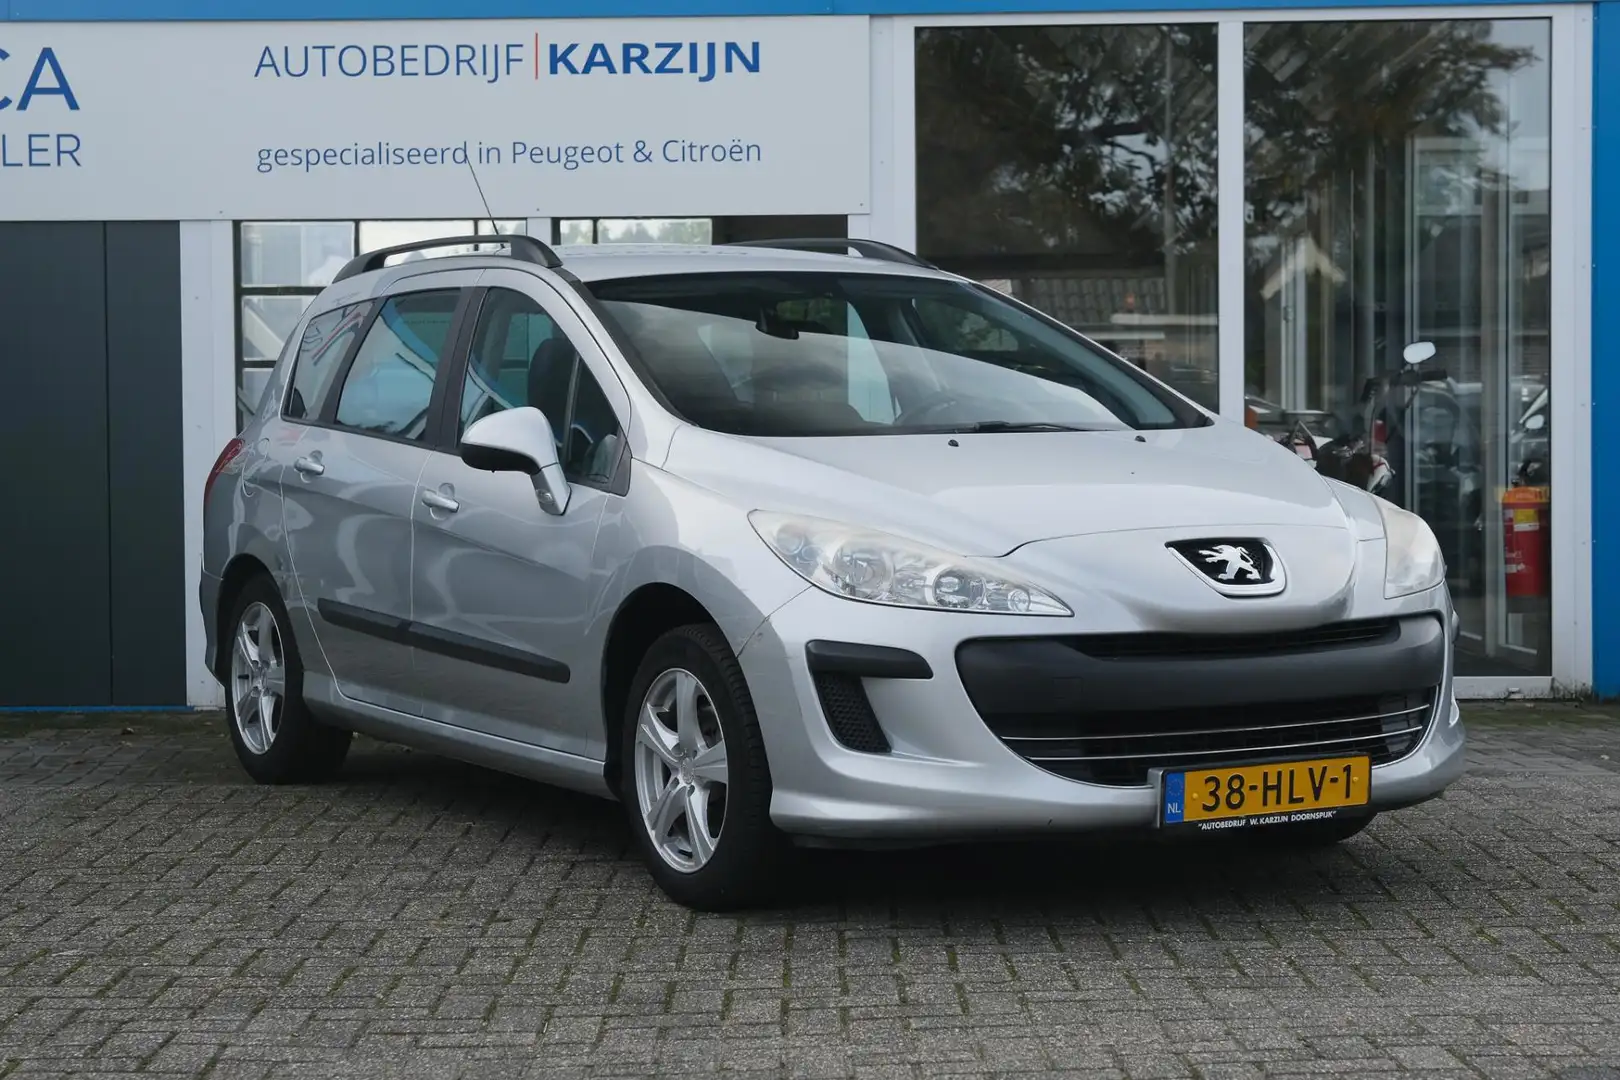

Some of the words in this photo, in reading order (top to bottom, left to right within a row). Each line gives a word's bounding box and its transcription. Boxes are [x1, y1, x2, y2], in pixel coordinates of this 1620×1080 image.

[0, 46, 80, 111] A
[254, 44, 524, 83] AUTOBEDRIJF
[549, 41, 760, 82] KARZIJN
[2, 133, 81, 167] LER
[257, 141, 468, 173] gespecialiseerd
[478, 142, 500, 164] in
[512, 142, 624, 170] Peugeot
[633, 140, 653, 163] &
[663, 139, 761, 162] Citroën
[1201, 764, 1352, 812] 38-HLV-1
[1167, 802, 1181, 815] NL
[1259, 815, 1289, 825] KARZIJN
